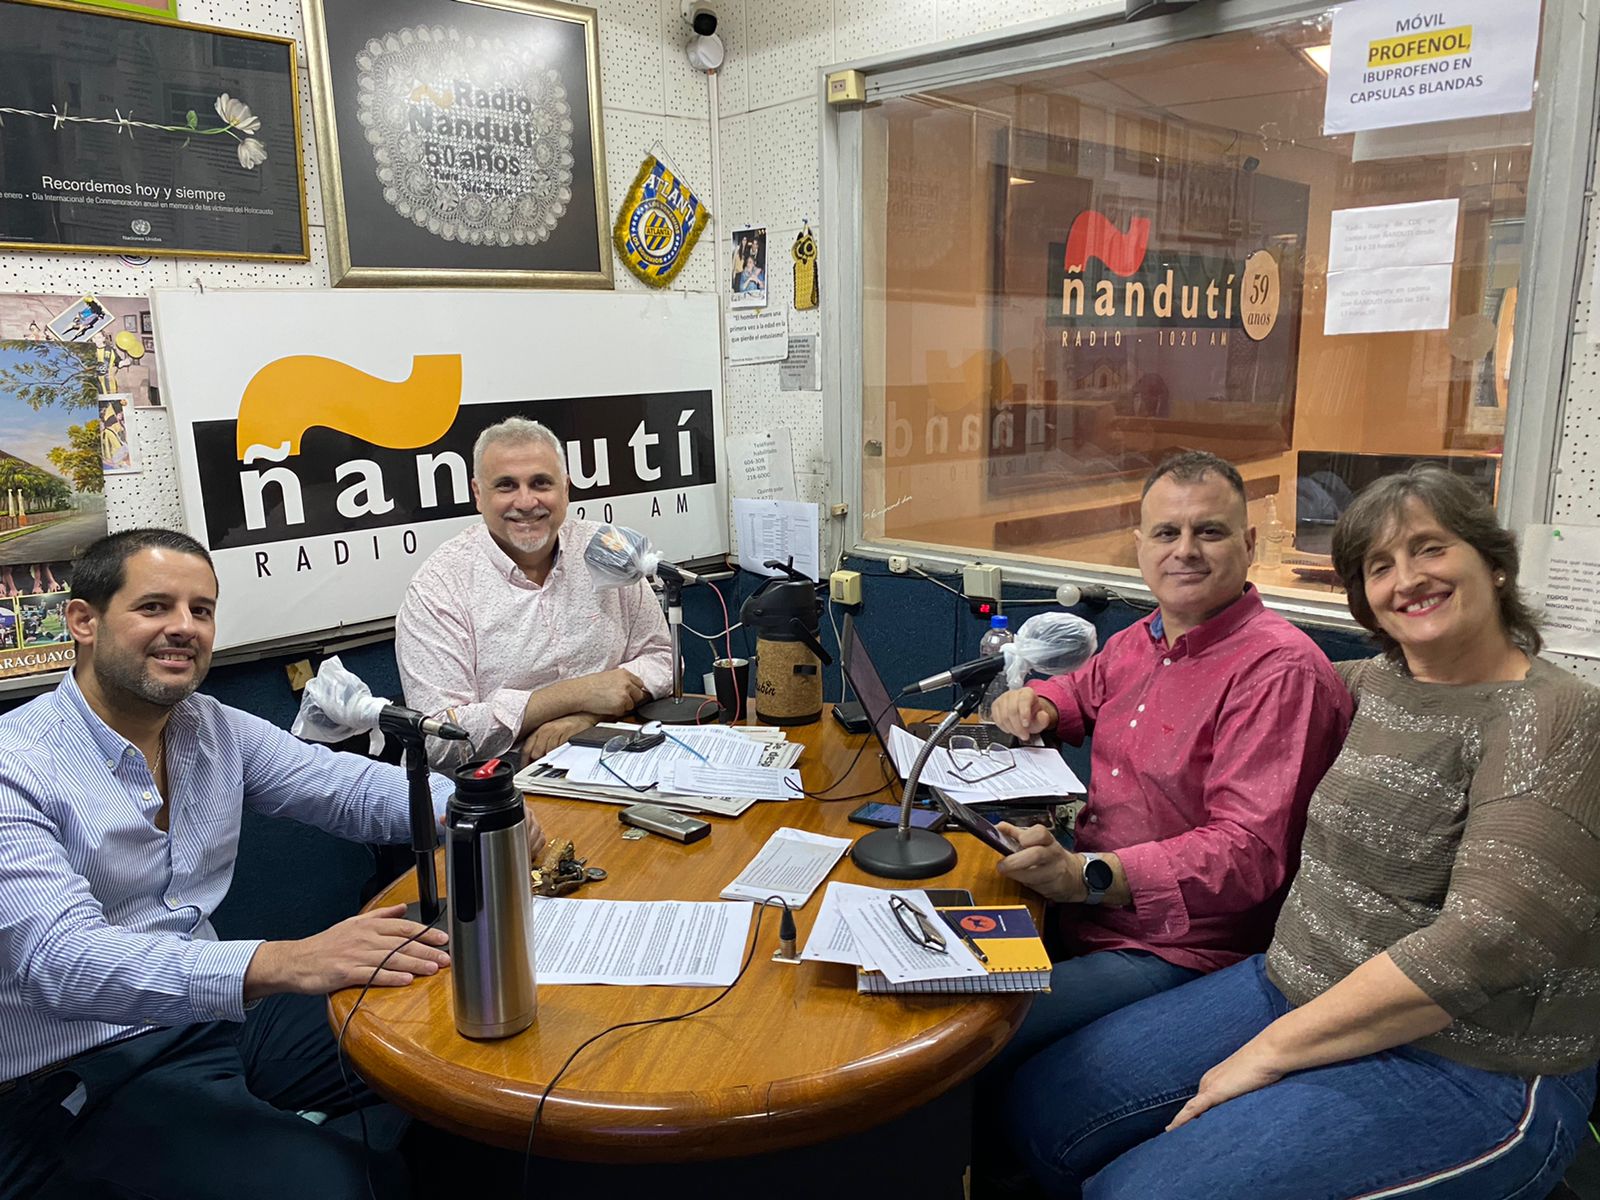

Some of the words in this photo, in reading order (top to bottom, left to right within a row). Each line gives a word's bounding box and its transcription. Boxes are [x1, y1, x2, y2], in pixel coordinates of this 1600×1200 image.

[1396, 13, 1446, 32] MÓVIL
[1368, 33, 1471, 62] PROFENOL,
[1363, 60, 1449, 83] IBUPROFENO
[1453, 57, 1472, 70] EN
[455, 80, 531, 115] Radio
[1350, 85, 1415, 104] CAPSULAS
[1419, 74, 1483, 95] BLANDAS
[460, 144, 521, 176] años
[42, 176, 132, 194] Recordemos
[136, 183, 160, 199] hoy
[163, 188, 171, 200] y
[176, 186, 226, 202] siempre
[45, 194, 84, 203] Internacional
[86, 196, 94, 204] de
[642, 174, 696, 227] ATLANTA
[646, 227, 672, 235] ATLANTA
[1062, 264, 1236, 320] ñandutí
[1250, 274, 1269, 306] 59
[1062, 330, 1122, 348] RADIO
[1159, 330, 1198, 347] 1020
[1209, 331, 1228, 347] AM
[240, 409, 696, 531] ñanutí
[255, 530, 417, 578] RADIO
[651, 493, 688, 517] AM
